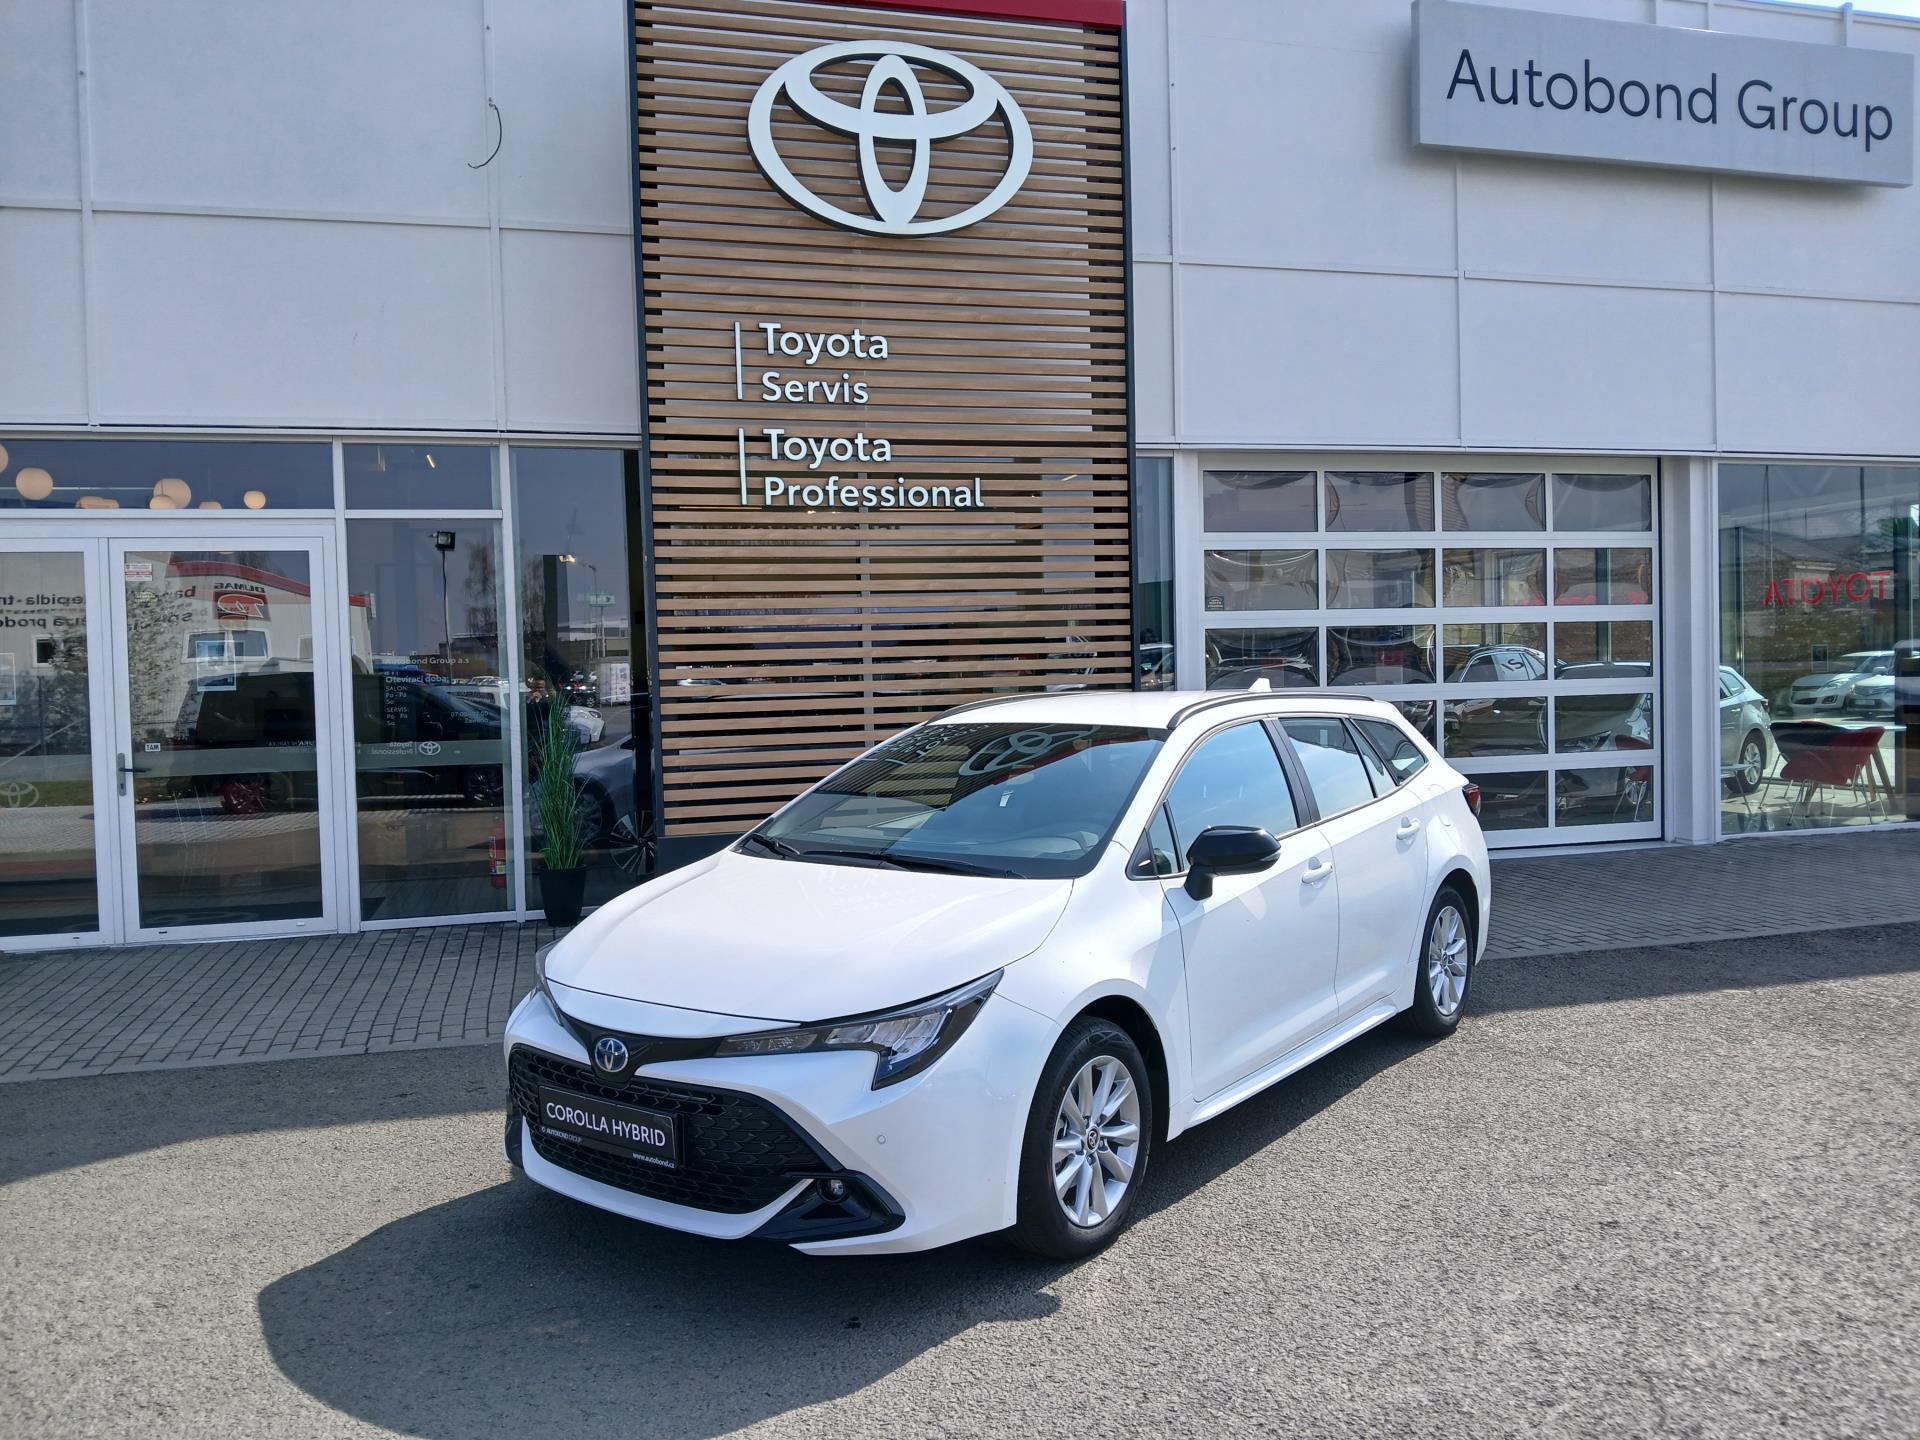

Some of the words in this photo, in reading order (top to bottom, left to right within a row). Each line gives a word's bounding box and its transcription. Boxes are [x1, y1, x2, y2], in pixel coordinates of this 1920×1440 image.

[1446, 48, 1719, 125] Autobond
[1737, 79, 1894, 152] Group
[758, 322, 889, 365] Toyota
[762, 371, 869, 404] Servis
[762, 428, 892, 470] Toyota
[764, 475, 985, 508] Professional
[546, 1102, 610, 1134] COROLLA
[612, 1118, 666, 1147] HYBRID
